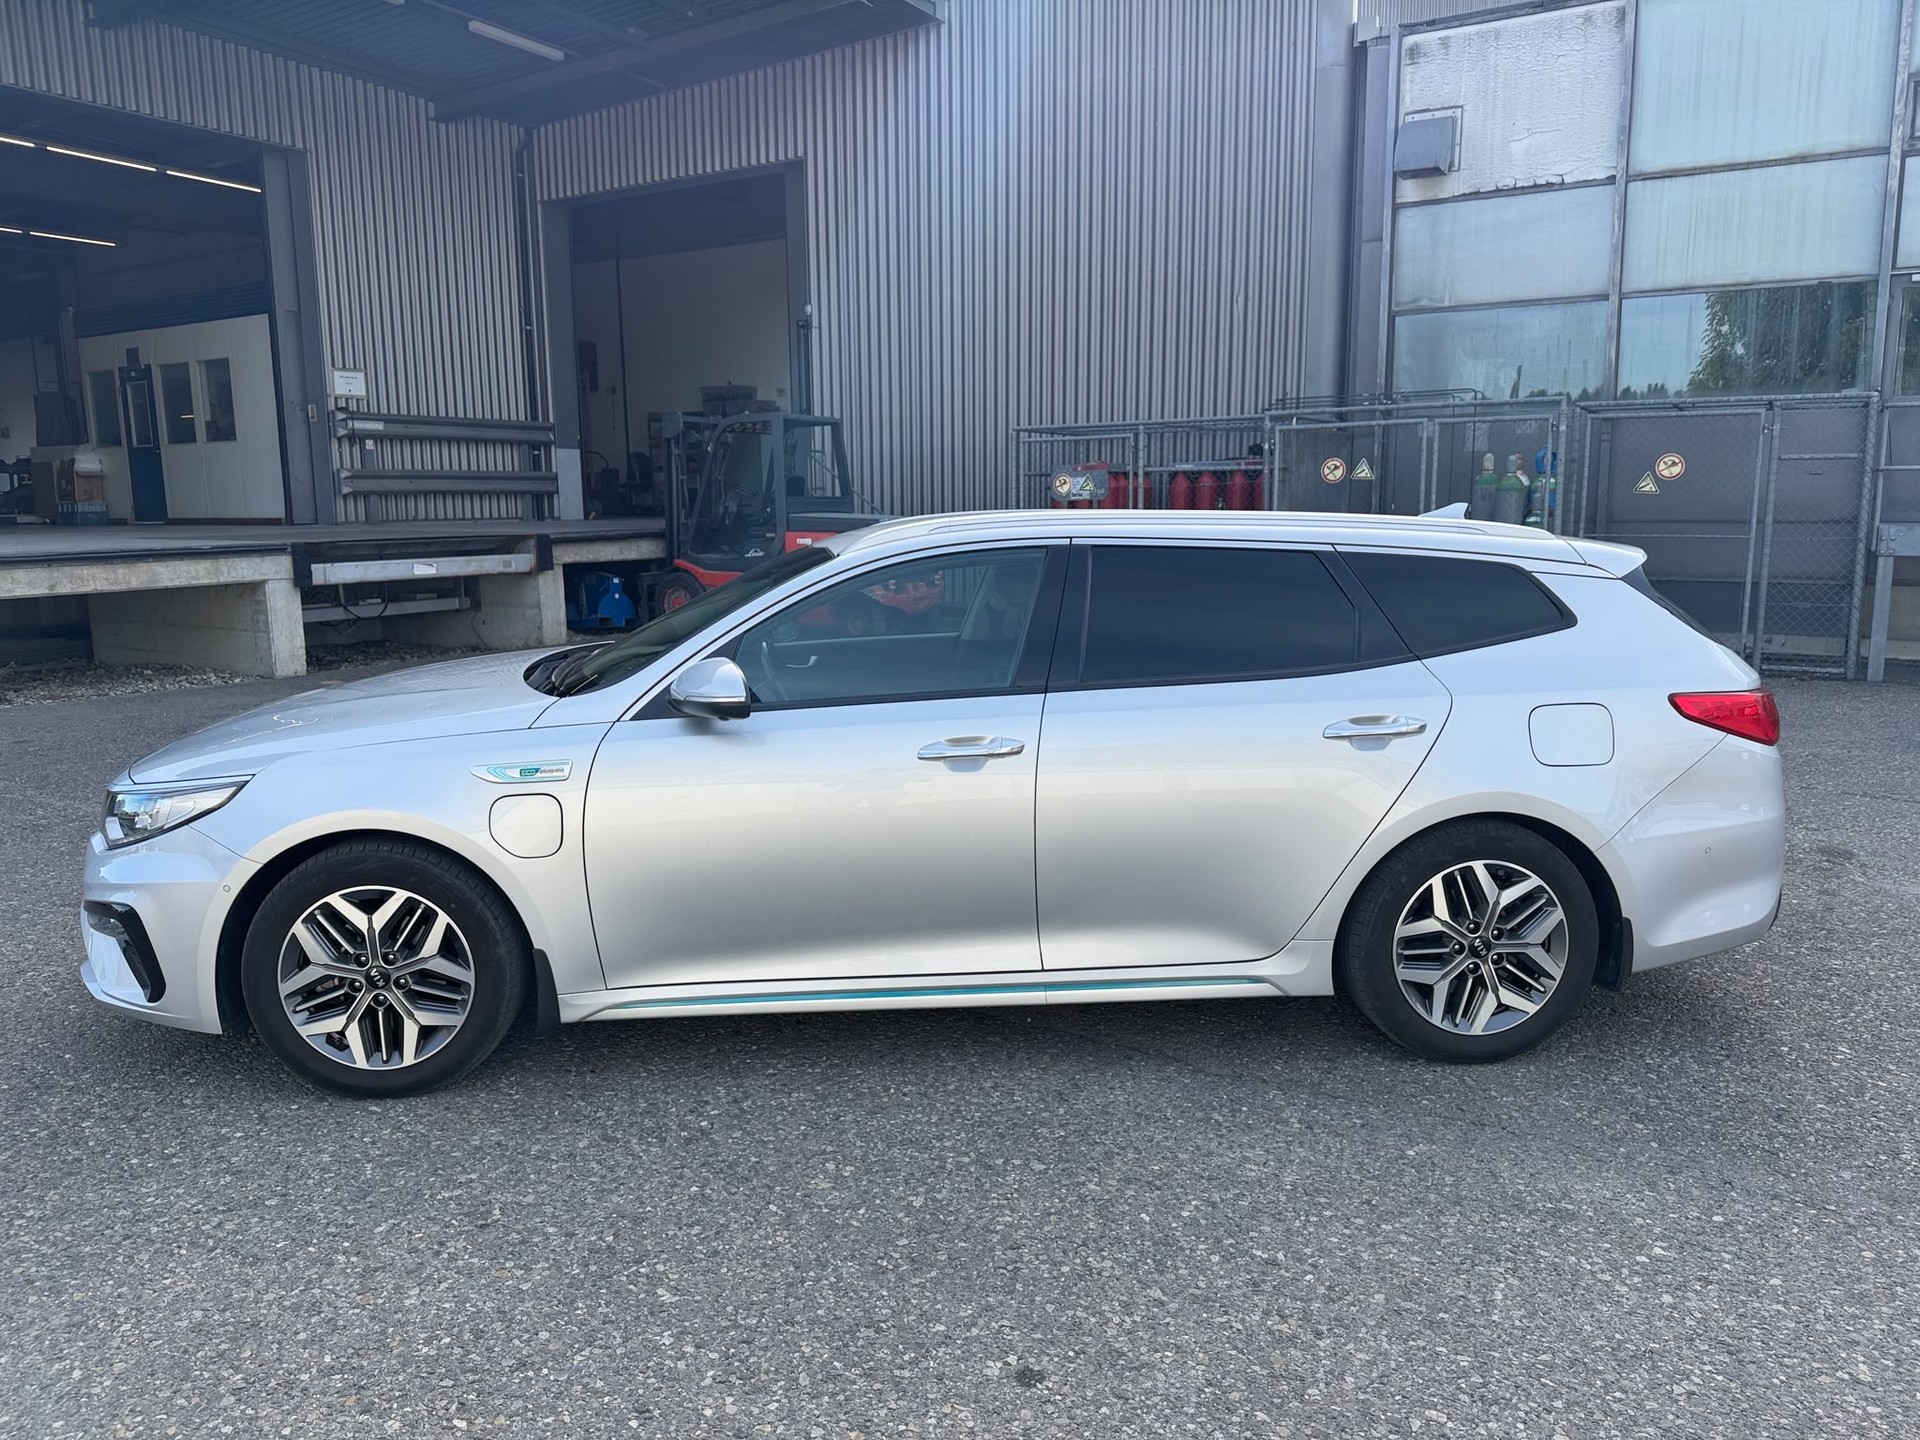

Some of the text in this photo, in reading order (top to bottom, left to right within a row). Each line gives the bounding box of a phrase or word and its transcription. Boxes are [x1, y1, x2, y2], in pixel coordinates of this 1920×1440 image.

[520, 769, 537, 777] ECO
[1473, 938, 1488, 957] KIA
[370, 967, 386, 988] KIA
